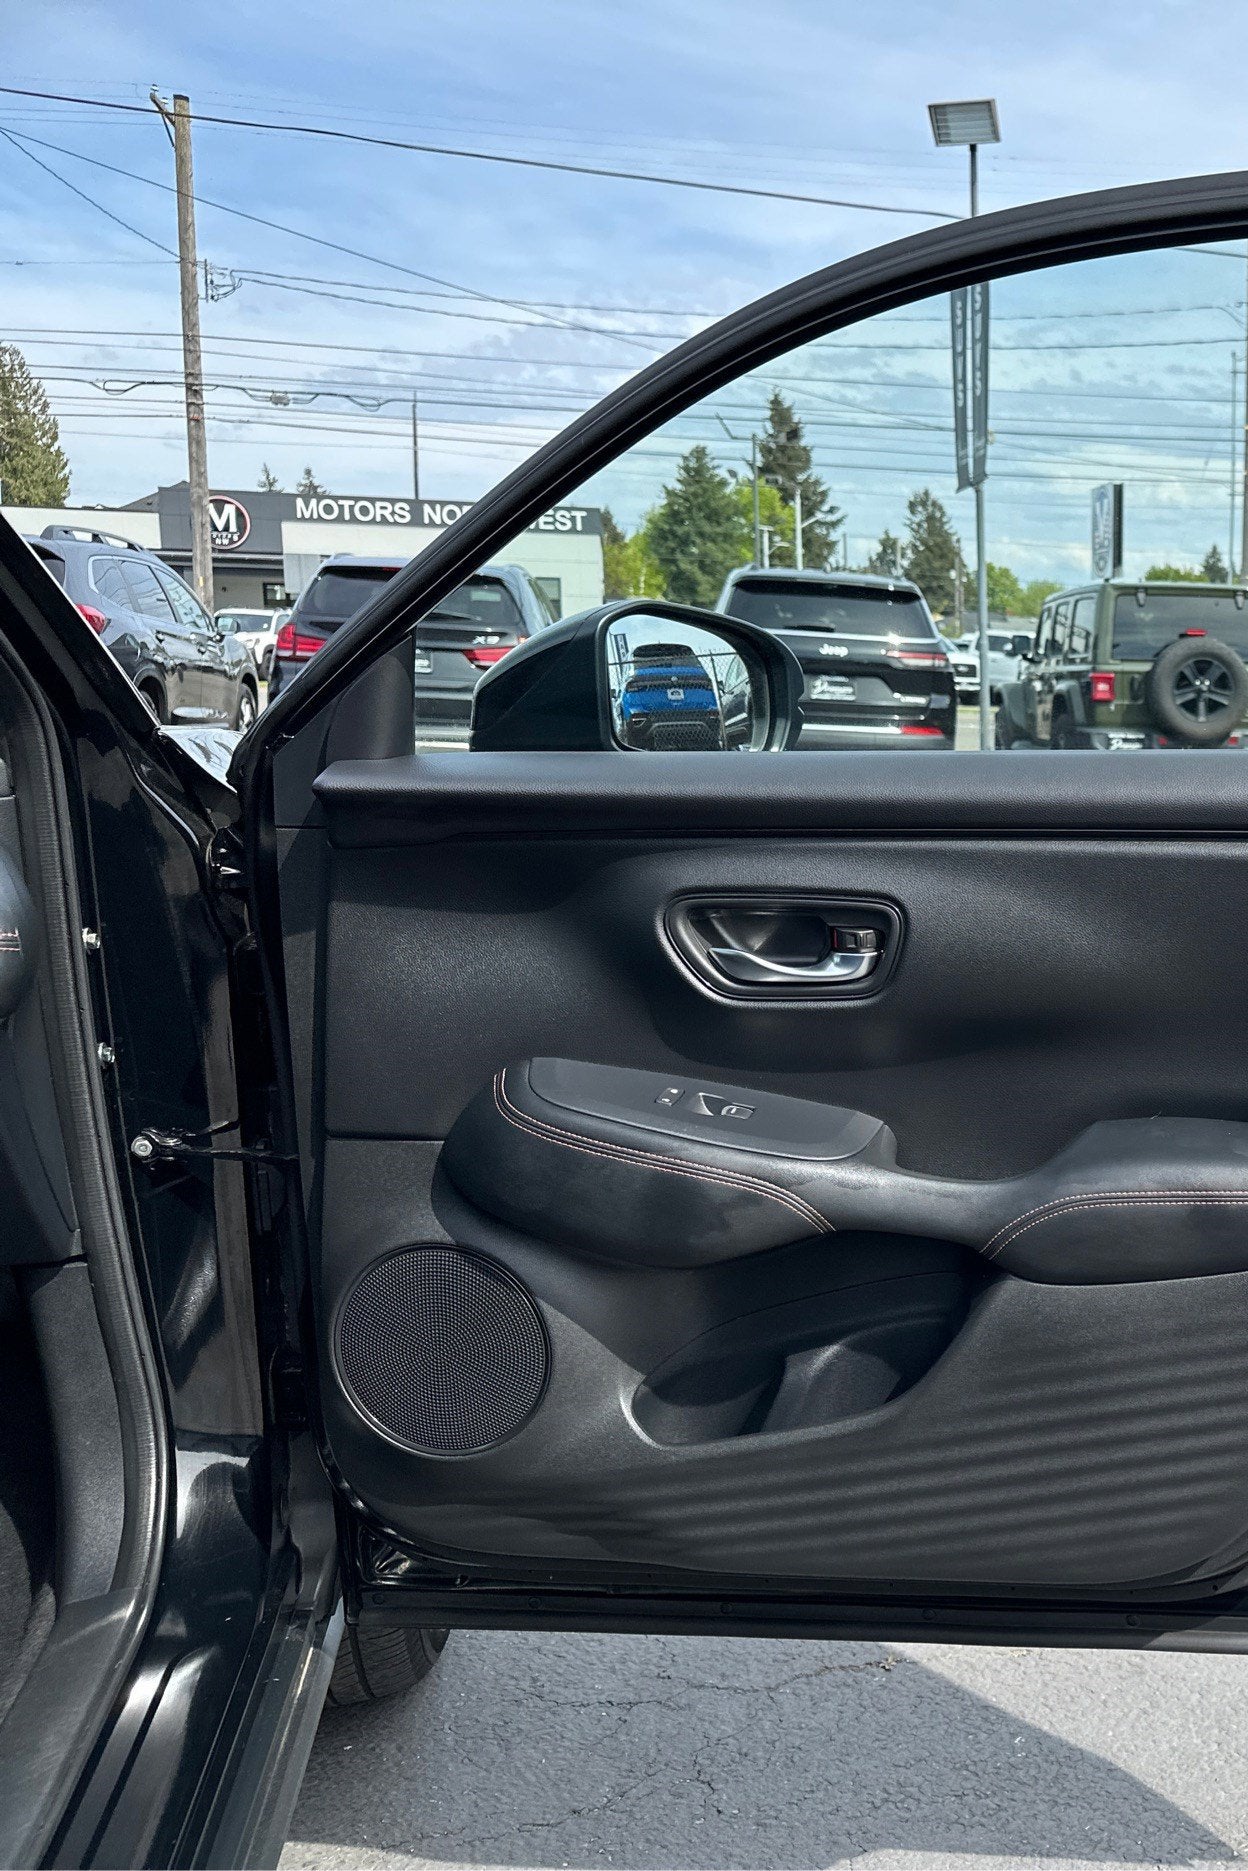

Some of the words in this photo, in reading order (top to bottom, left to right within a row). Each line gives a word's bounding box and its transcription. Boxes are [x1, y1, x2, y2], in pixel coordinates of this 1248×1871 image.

[295, 497, 412, 524] MOTORS
[423, 503, 588, 531] NOEST
[819, 643, 848, 657] Jeep
